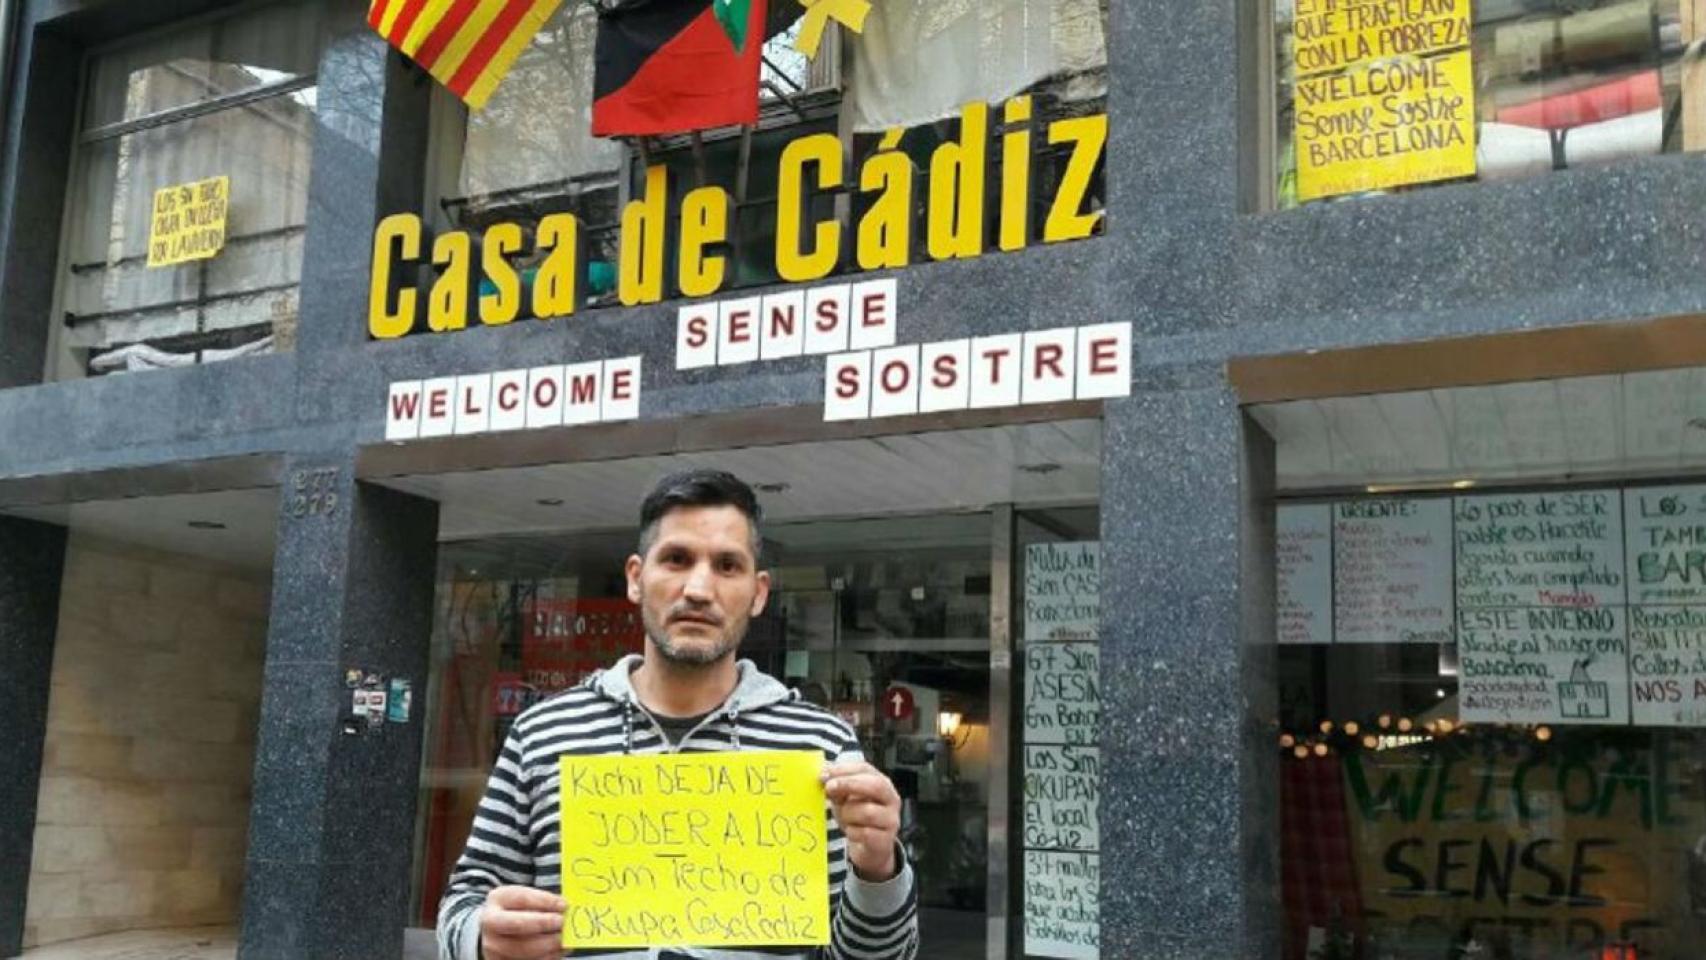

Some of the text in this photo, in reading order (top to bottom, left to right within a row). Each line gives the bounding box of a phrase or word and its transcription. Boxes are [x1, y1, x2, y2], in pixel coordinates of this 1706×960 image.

[1295, 12, 1336, 42] QUE
[1295, 17, 1471, 70] CON LA POBREZA
[1297, 57, 1451, 106] WELCOME
[1309, 123, 1466, 168] BARCELONA
[368, 94, 1108, 340] Casa de Cádiz
[685, 292, 887, 349] SENSE
[834, 338, 1119, 399] SOSTRE
[391, 369, 633, 421] WELCOME
[1535, 497, 1556, 517] de
[1560, 493, 1608, 517] SER
[1459, 608, 1615, 633] ESTE INVIERNO
[746, 763, 785, 797] DE
[587, 809, 819, 854] JODER A LOS
[655, 853, 761, 897] Techo
[769, 856, 808, 901] de
[1383, 837, 1618, 905] SENSE
